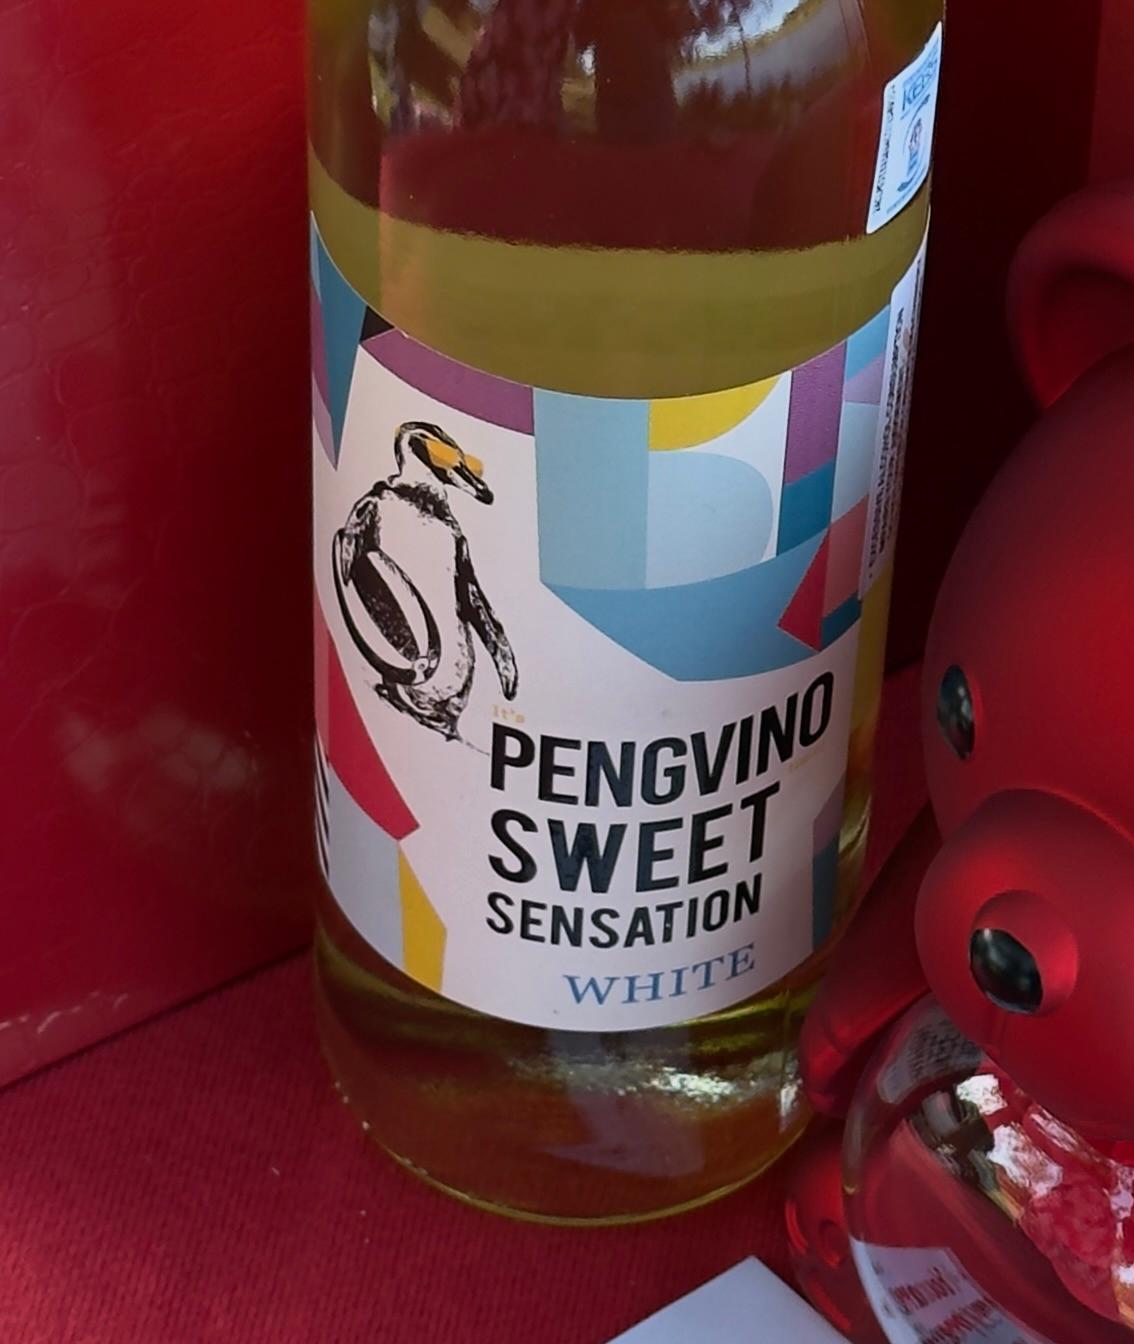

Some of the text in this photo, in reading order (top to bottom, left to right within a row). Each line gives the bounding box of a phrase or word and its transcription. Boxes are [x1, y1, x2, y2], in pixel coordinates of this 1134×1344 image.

[490, 671, 834, 807] PENGVINO
[488, 781, 780, 894] SWEET
[486, 872, 763, 949] SENSATION
[563, 942, 756, 1006] WHITE
